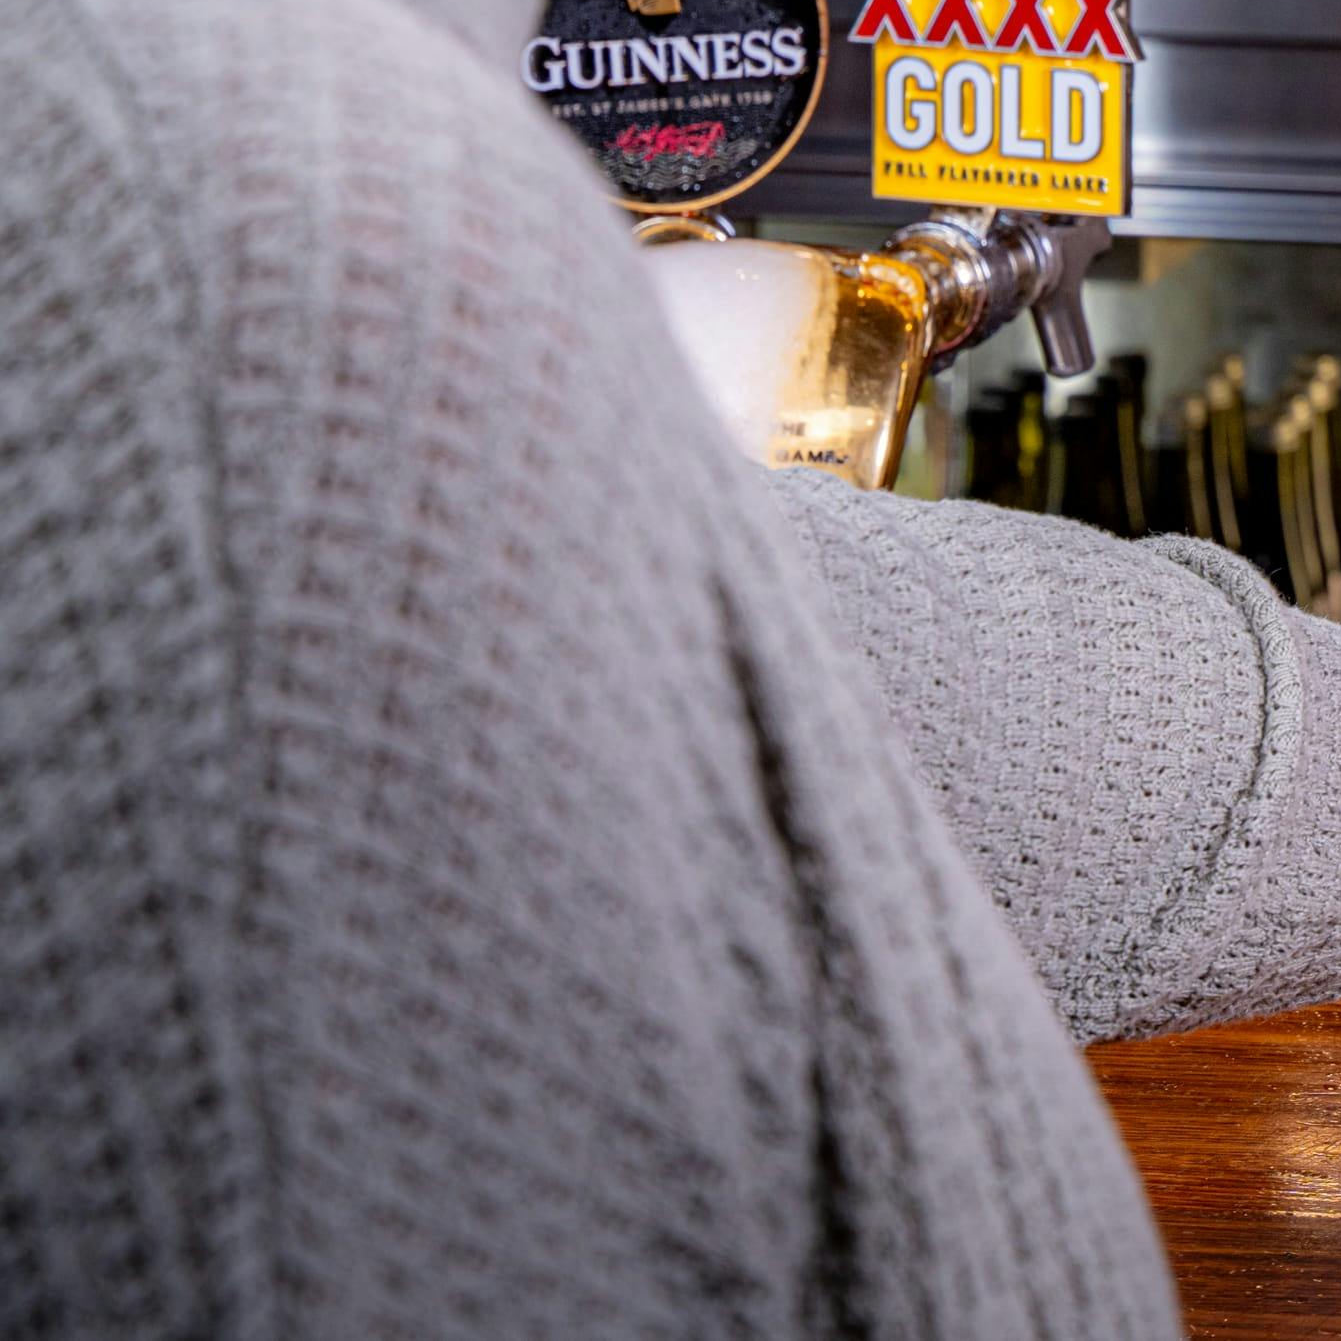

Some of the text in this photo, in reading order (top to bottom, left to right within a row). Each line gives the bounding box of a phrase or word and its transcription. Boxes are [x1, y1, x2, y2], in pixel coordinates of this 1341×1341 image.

[520, 27, 807, 93] GUINNESS
[885, 57, 1103, 163] GOLD
[884, 160, 1108, 194] FULL FLAVOURED LAGER
